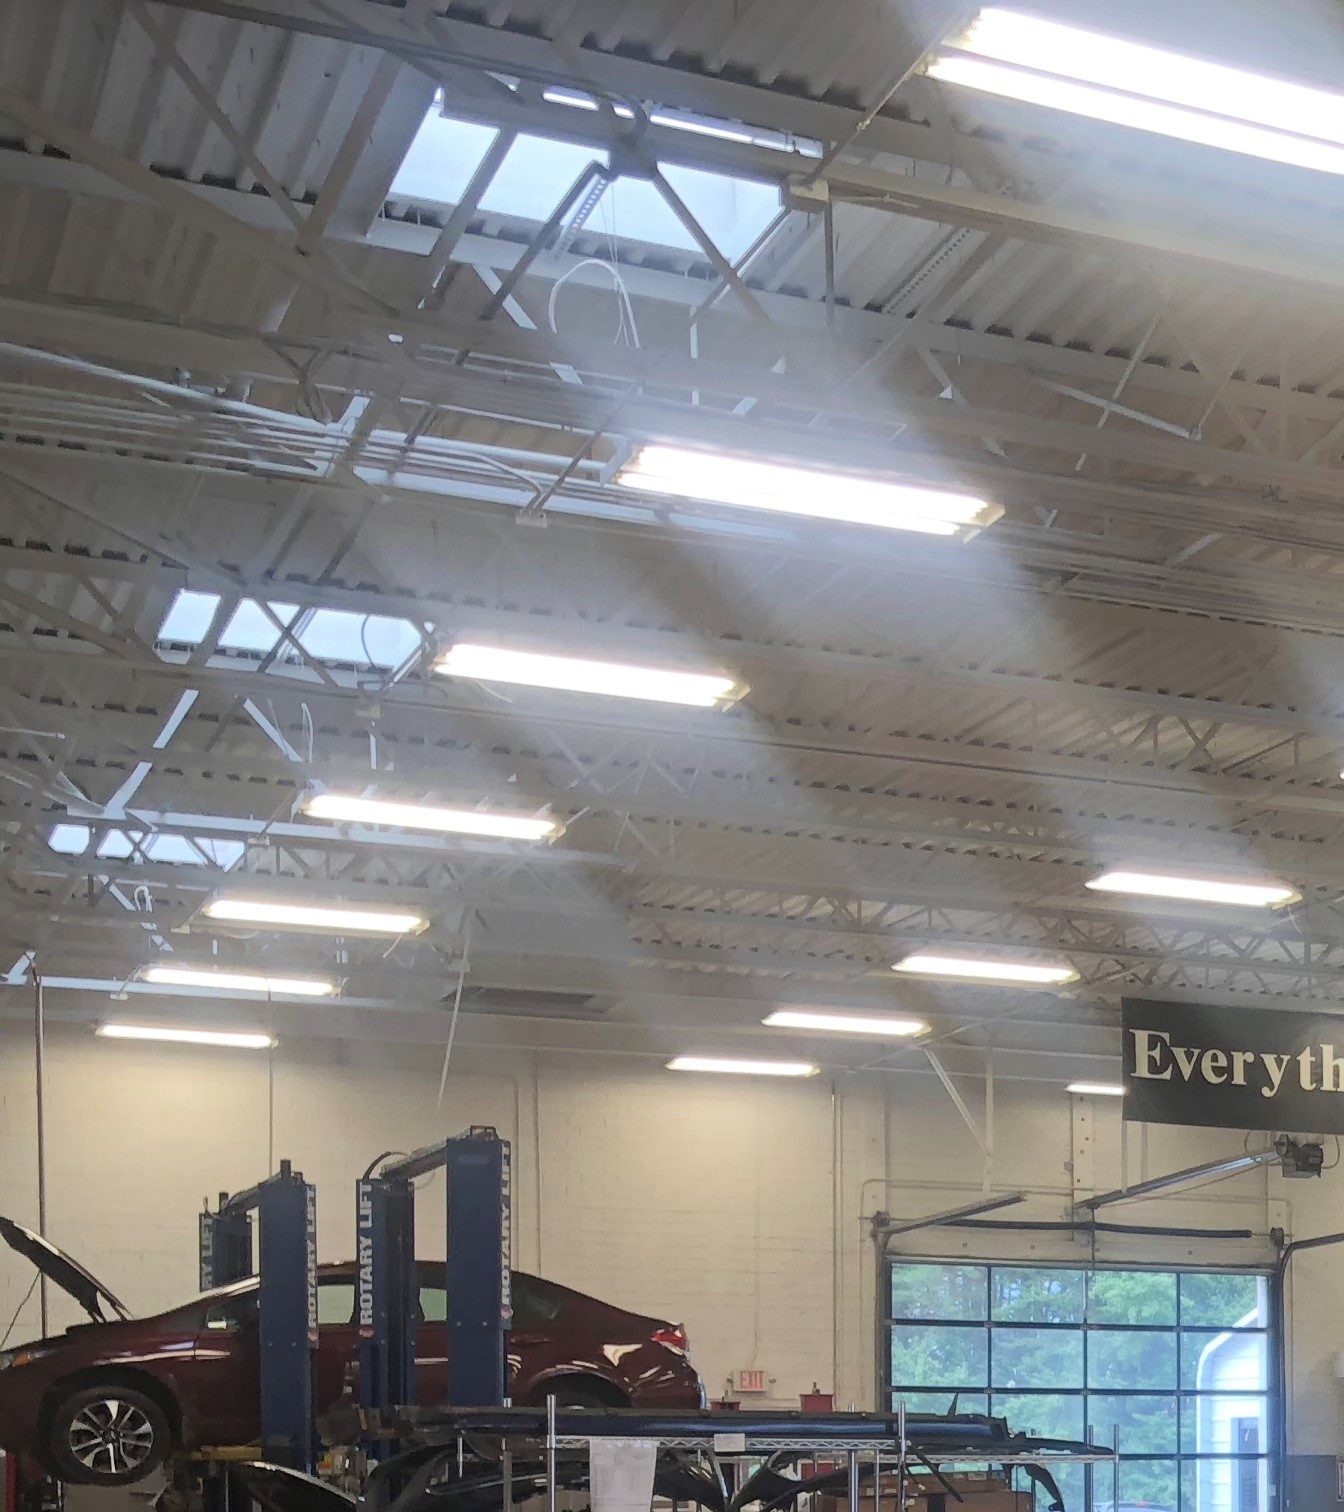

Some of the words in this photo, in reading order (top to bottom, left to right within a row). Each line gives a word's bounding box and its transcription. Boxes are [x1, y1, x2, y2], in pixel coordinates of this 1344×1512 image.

[501, 1143, 510, 1196] LIFT
[307, 1187, 315, 1232] LIFT
[360, 1182, 373, 1228] LIFT
[360, 1235, 373, 1325] ROTARY
[501, 1203, 510, 1305] ROTARY
[307, 1240, 316, 1328] ROTARY
[740, 1370, 764, 1389] EXIT
